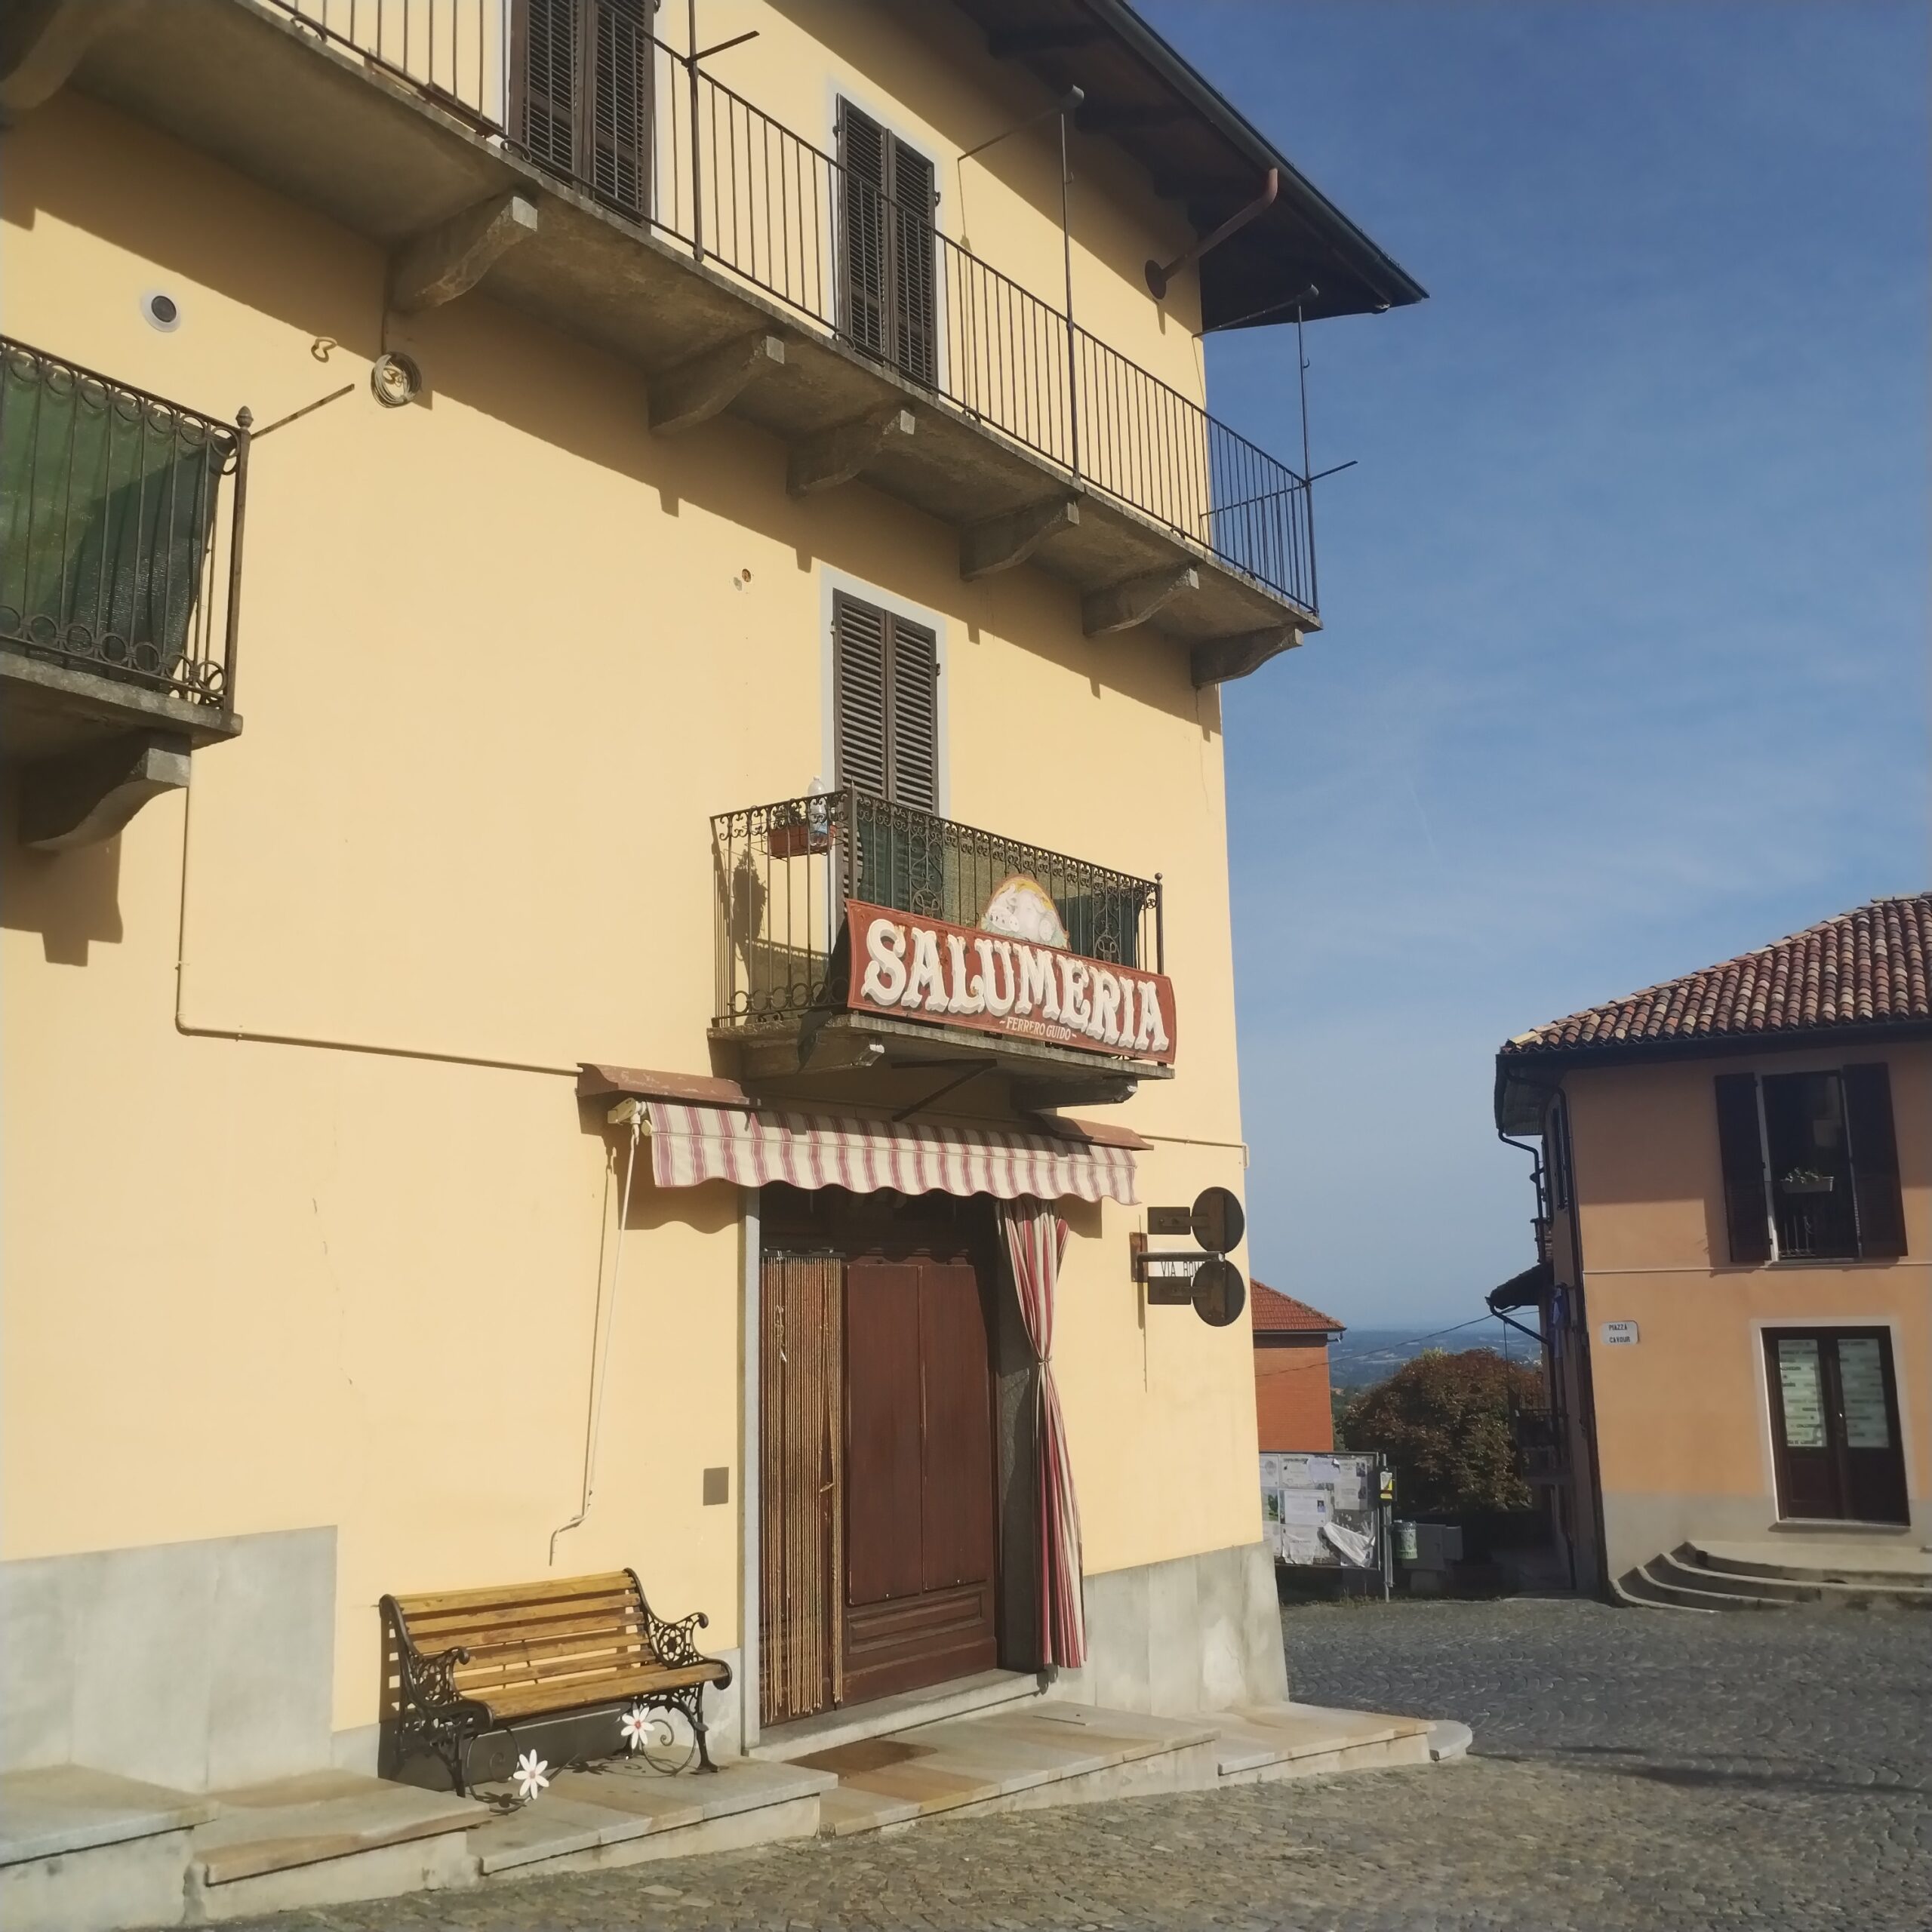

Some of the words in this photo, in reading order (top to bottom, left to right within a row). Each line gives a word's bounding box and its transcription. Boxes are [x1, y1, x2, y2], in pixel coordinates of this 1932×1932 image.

[862, 918, 1169, 1051] SALUMERIA
[1006, 1017, 1045, 1035] FERRERO
[1046, 1025, 1071, 1041] GUIDO
[1161, 1261, 1177, 1277] VIA
[1183, 1261, 1204, 1277] ROM
